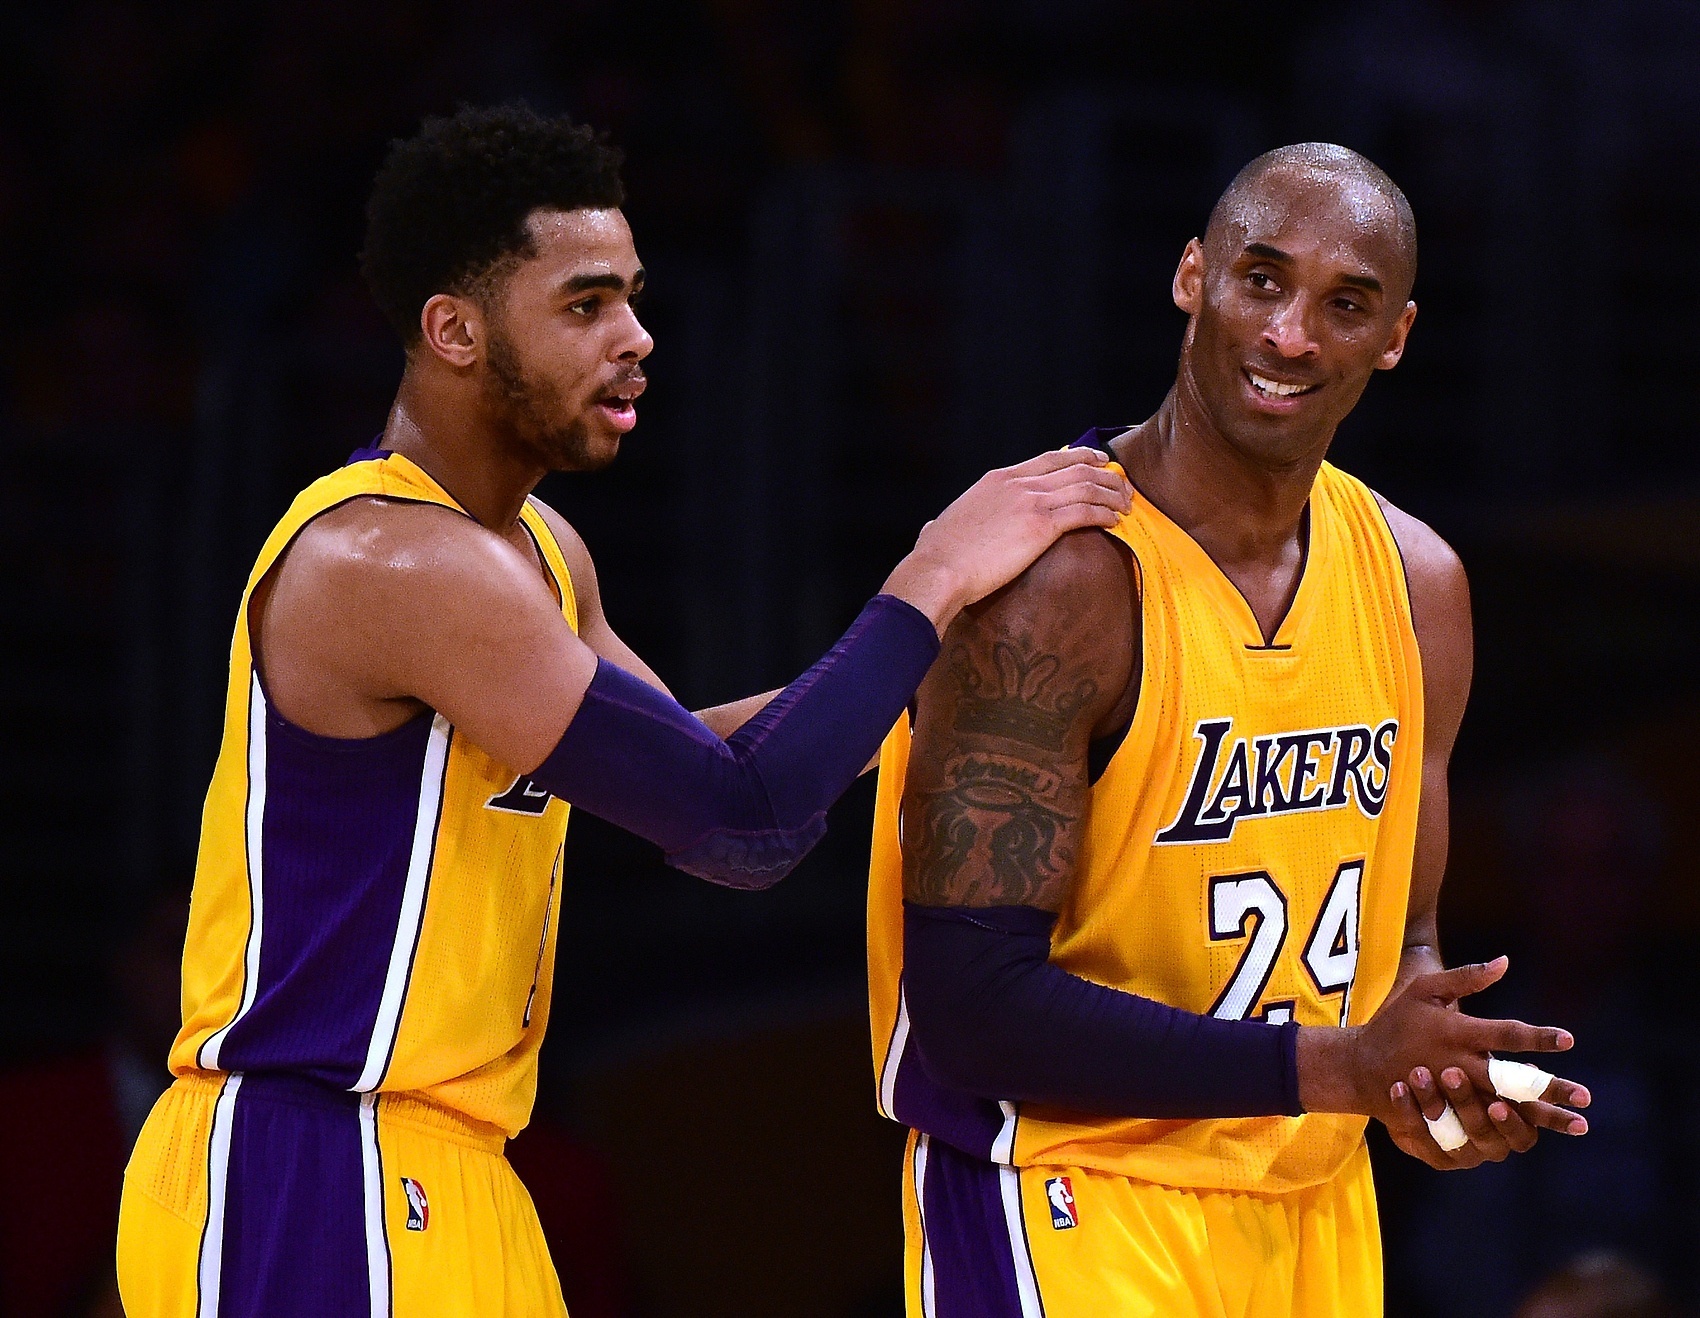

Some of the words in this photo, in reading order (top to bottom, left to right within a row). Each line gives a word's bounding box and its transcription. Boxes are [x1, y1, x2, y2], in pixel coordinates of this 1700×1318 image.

[1154, 717, 1399, 844] LAKERS
[1208, 859, 1366, 1028] 24
[1053, 1216, 1072, 1229] NBA
